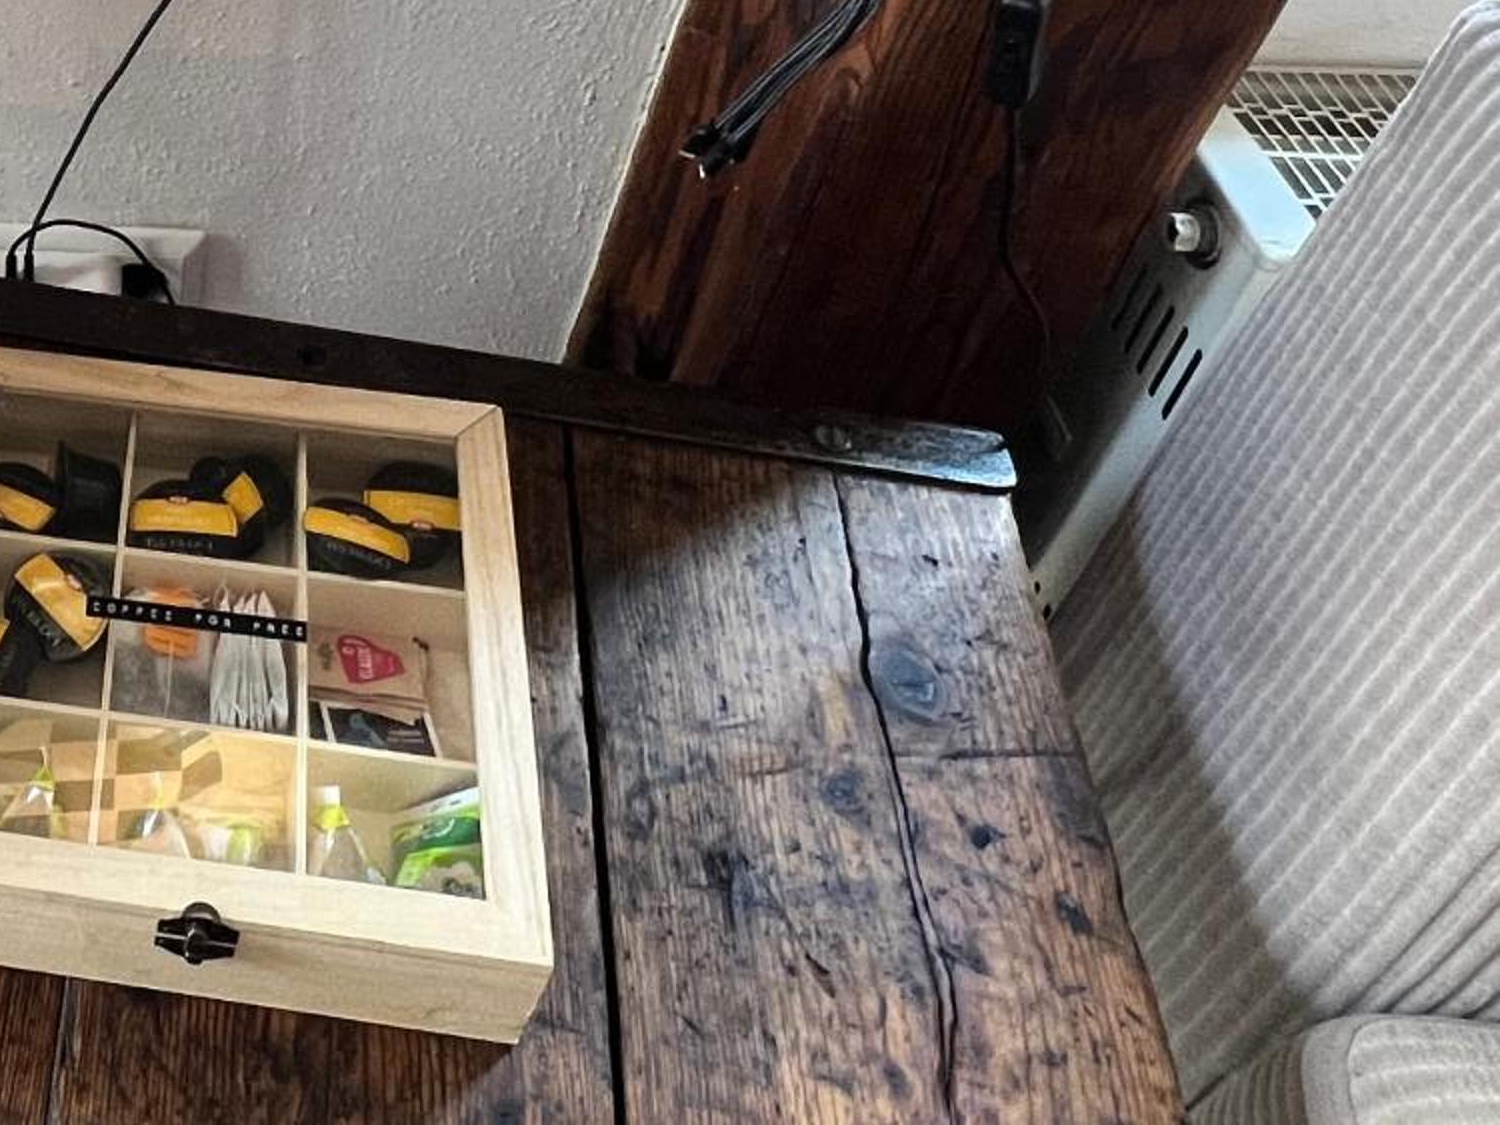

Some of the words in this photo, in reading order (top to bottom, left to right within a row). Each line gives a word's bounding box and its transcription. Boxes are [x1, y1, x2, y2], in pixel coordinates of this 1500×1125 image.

[92, 601, 173, 622] COFFEE
[195, 613, 231, 629] FOR
[253, 621, 304, 637] FREE
